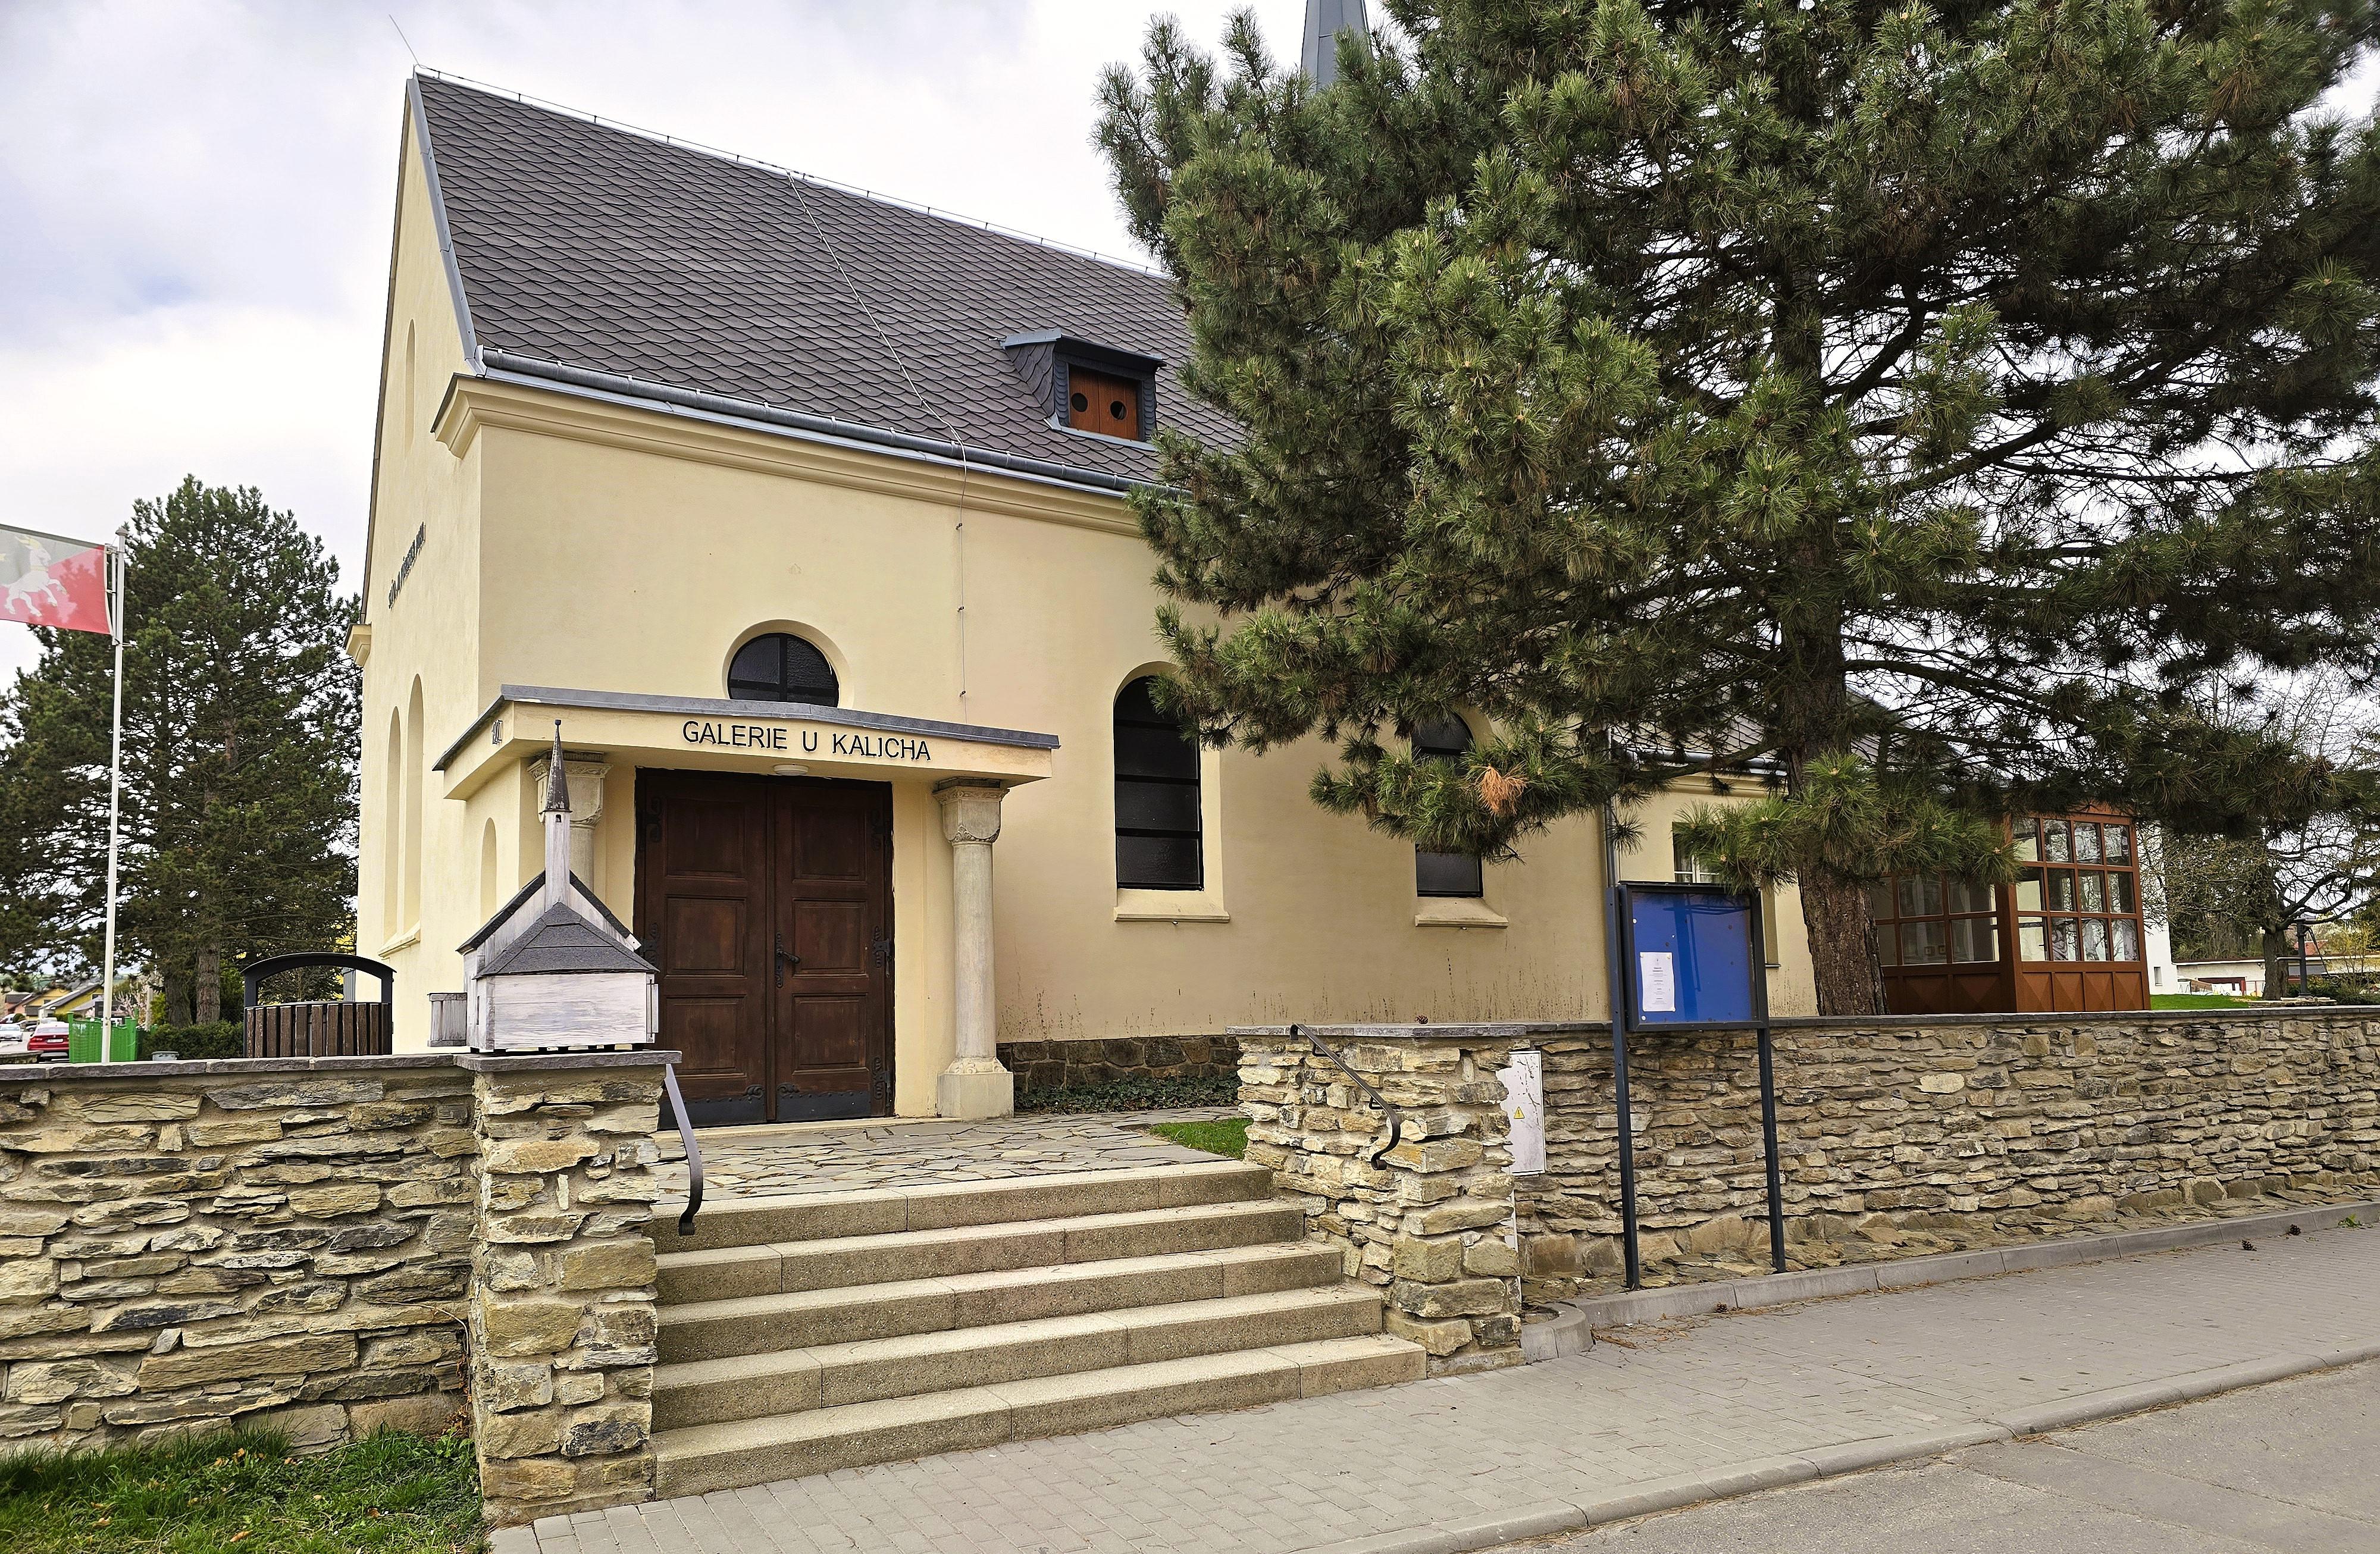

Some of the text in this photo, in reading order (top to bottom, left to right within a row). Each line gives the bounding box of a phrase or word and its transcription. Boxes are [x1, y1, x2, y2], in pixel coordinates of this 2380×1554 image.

[682, 720, 931, 762] GALERIE U KALICHA
